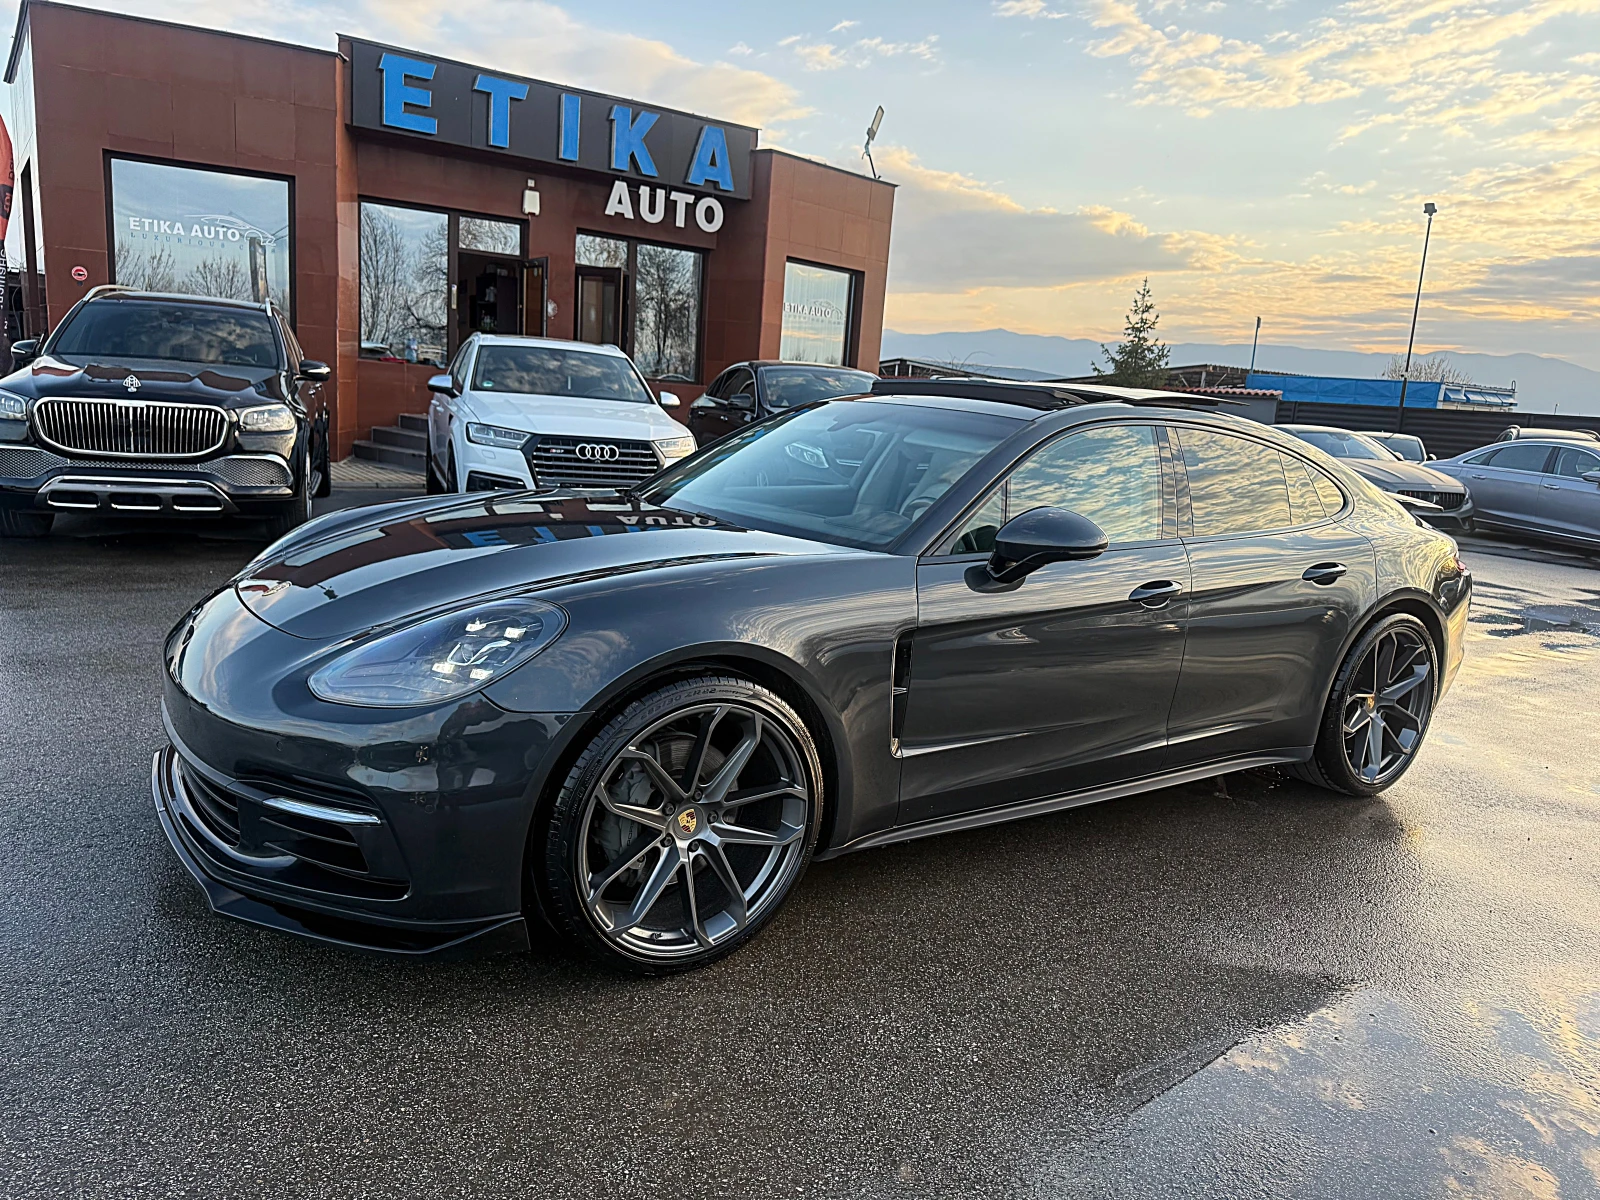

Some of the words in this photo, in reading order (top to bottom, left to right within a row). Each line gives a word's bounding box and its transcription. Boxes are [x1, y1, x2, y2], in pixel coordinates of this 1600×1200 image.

[378, 52, 735, 192] ETIKA
[604, 180, 725, 233] AUTO
[128, 217, 185, 236] ETIKA
[190, 224, 241, 242] AUTO
[130, 232, 225, 249] LUXURIOUS
[784, 302, 809, 315] ETIKA
[809, 306, 832, 318] AUTO
